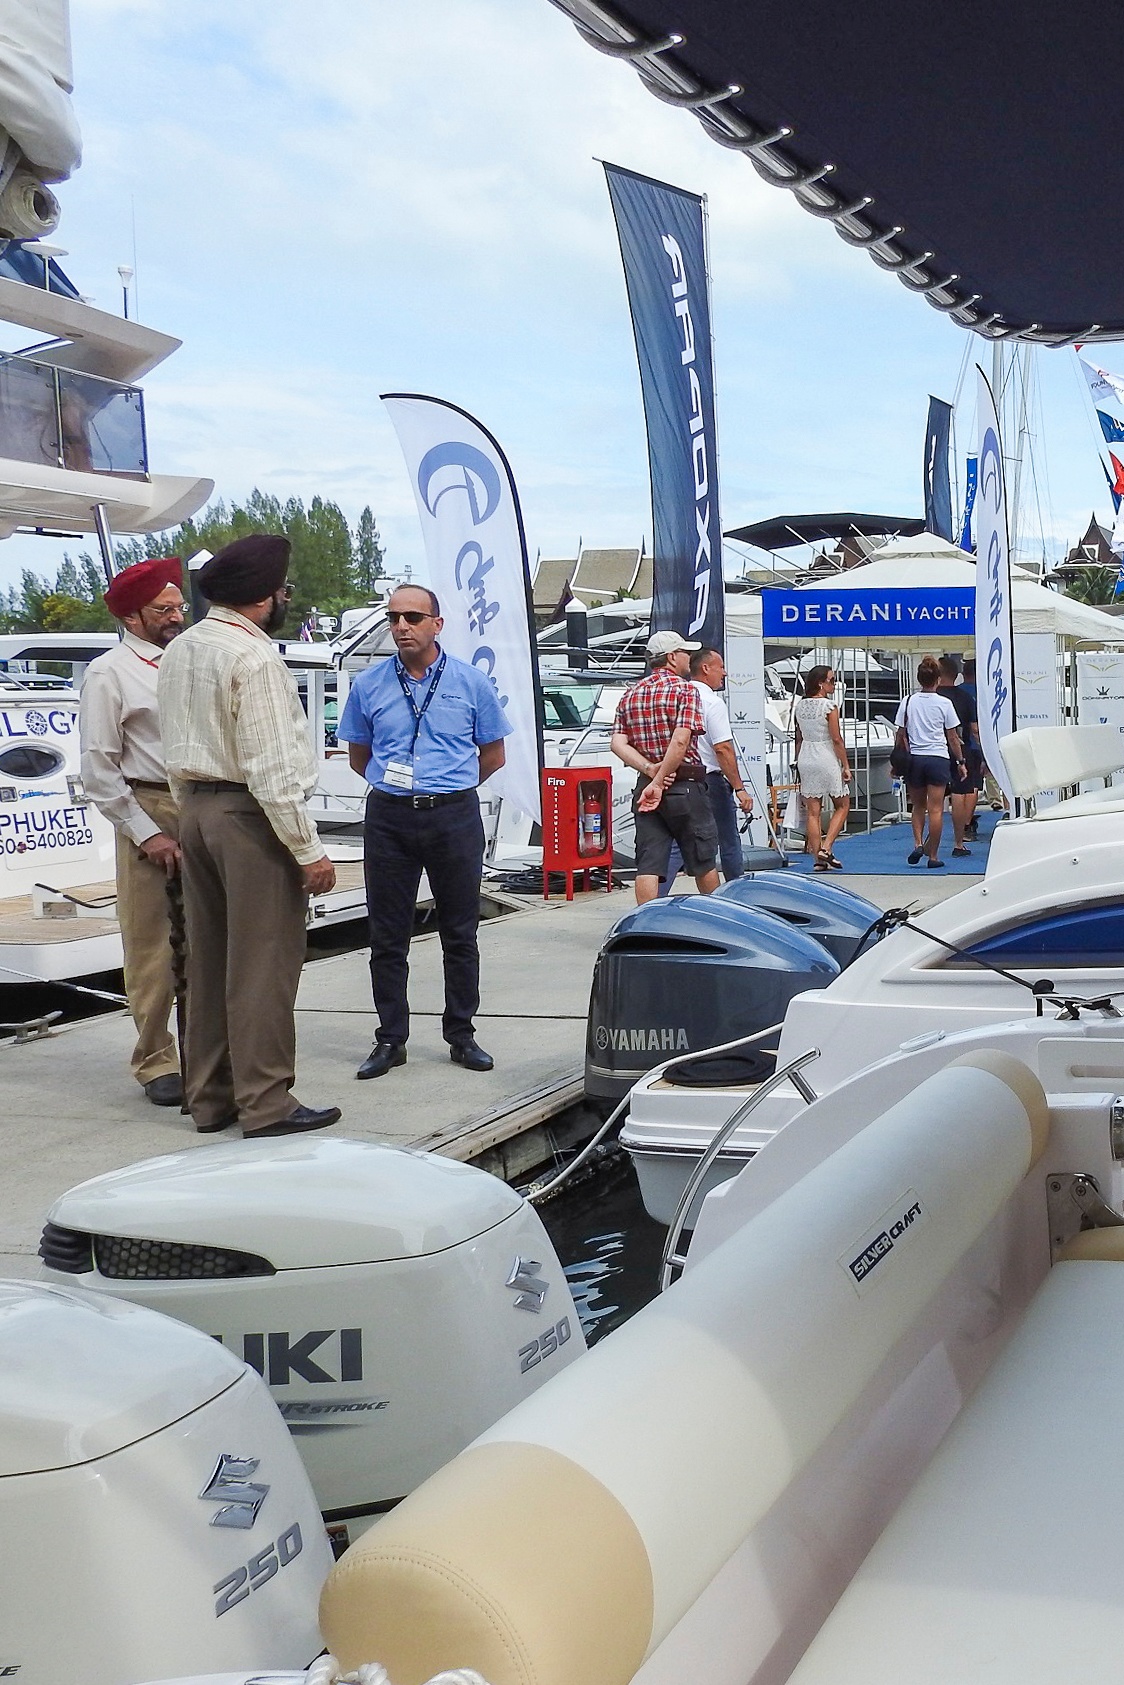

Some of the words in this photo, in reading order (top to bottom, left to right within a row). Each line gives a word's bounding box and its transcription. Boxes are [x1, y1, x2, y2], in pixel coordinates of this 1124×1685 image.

[782, 603, 901, 623] DERANI
[907, 606, 972, 621] YACHT
[547, 777, 566, 786] Fire
[608, 1028, 690, 1051] YAMAHA
[853, 1235, 892, 1277] SILVER
[889, 1202, 922, 1239] CRAFT
[518, 1316, 571, 1374] 250
[213, 1522, 303, 1619] 250
